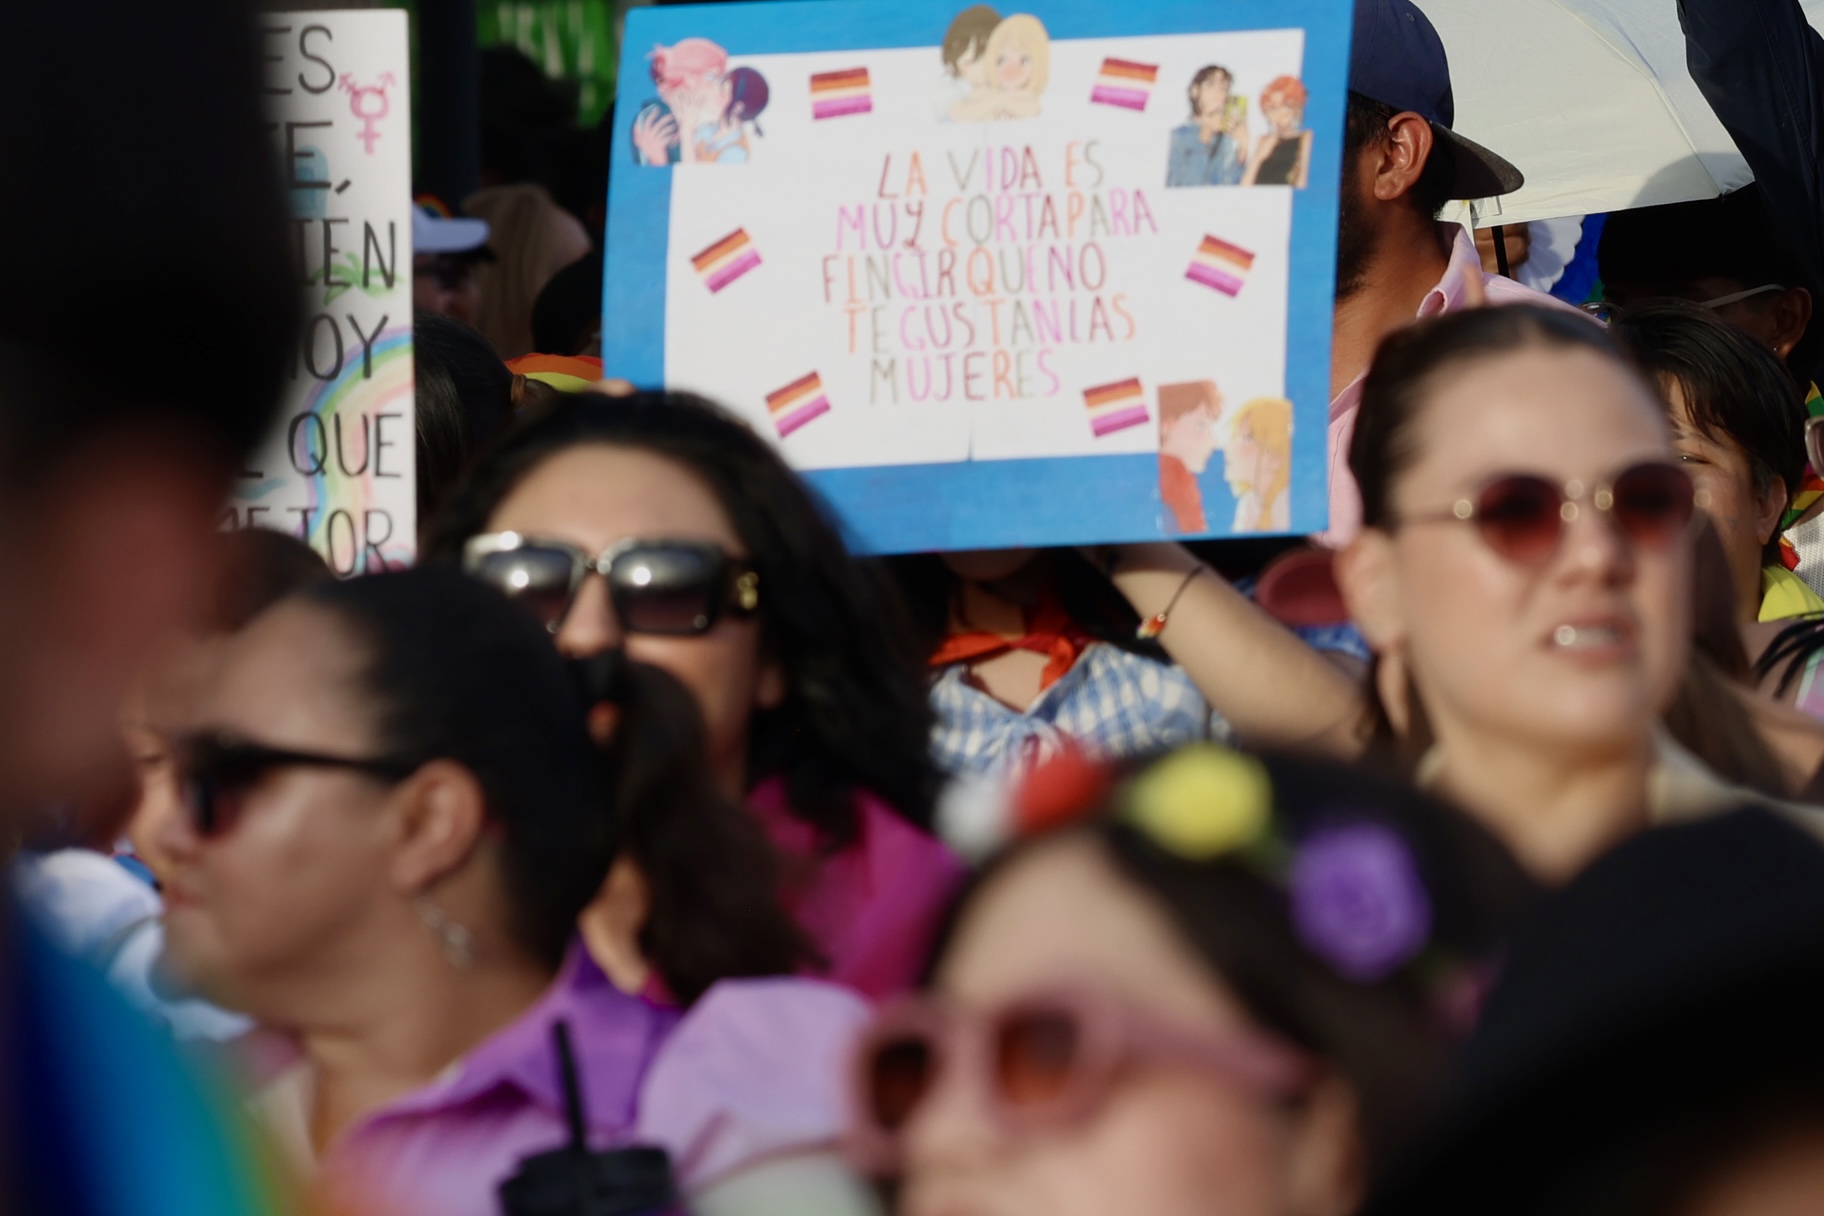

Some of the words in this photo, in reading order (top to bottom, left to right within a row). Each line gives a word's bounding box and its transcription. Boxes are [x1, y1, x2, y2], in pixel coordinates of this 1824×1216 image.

[877, 149, 928, 199] LA
[946, 143, 1043, 192] VIDA
[1064, 139, 1105, 188] ES
[836, 197, 924, 250] MUY
[965, 245, 1038, 297] QUE
[1047, 241, 1107, 293] NO
[842, 302, 891, 356] TE
[900, 296, 1063, 351] GUSTAN
[1070, 292, 1138, 344] LAS
[869, 347, 1061, 406] MUJERES
[287, 411, 402, 478] QUE
